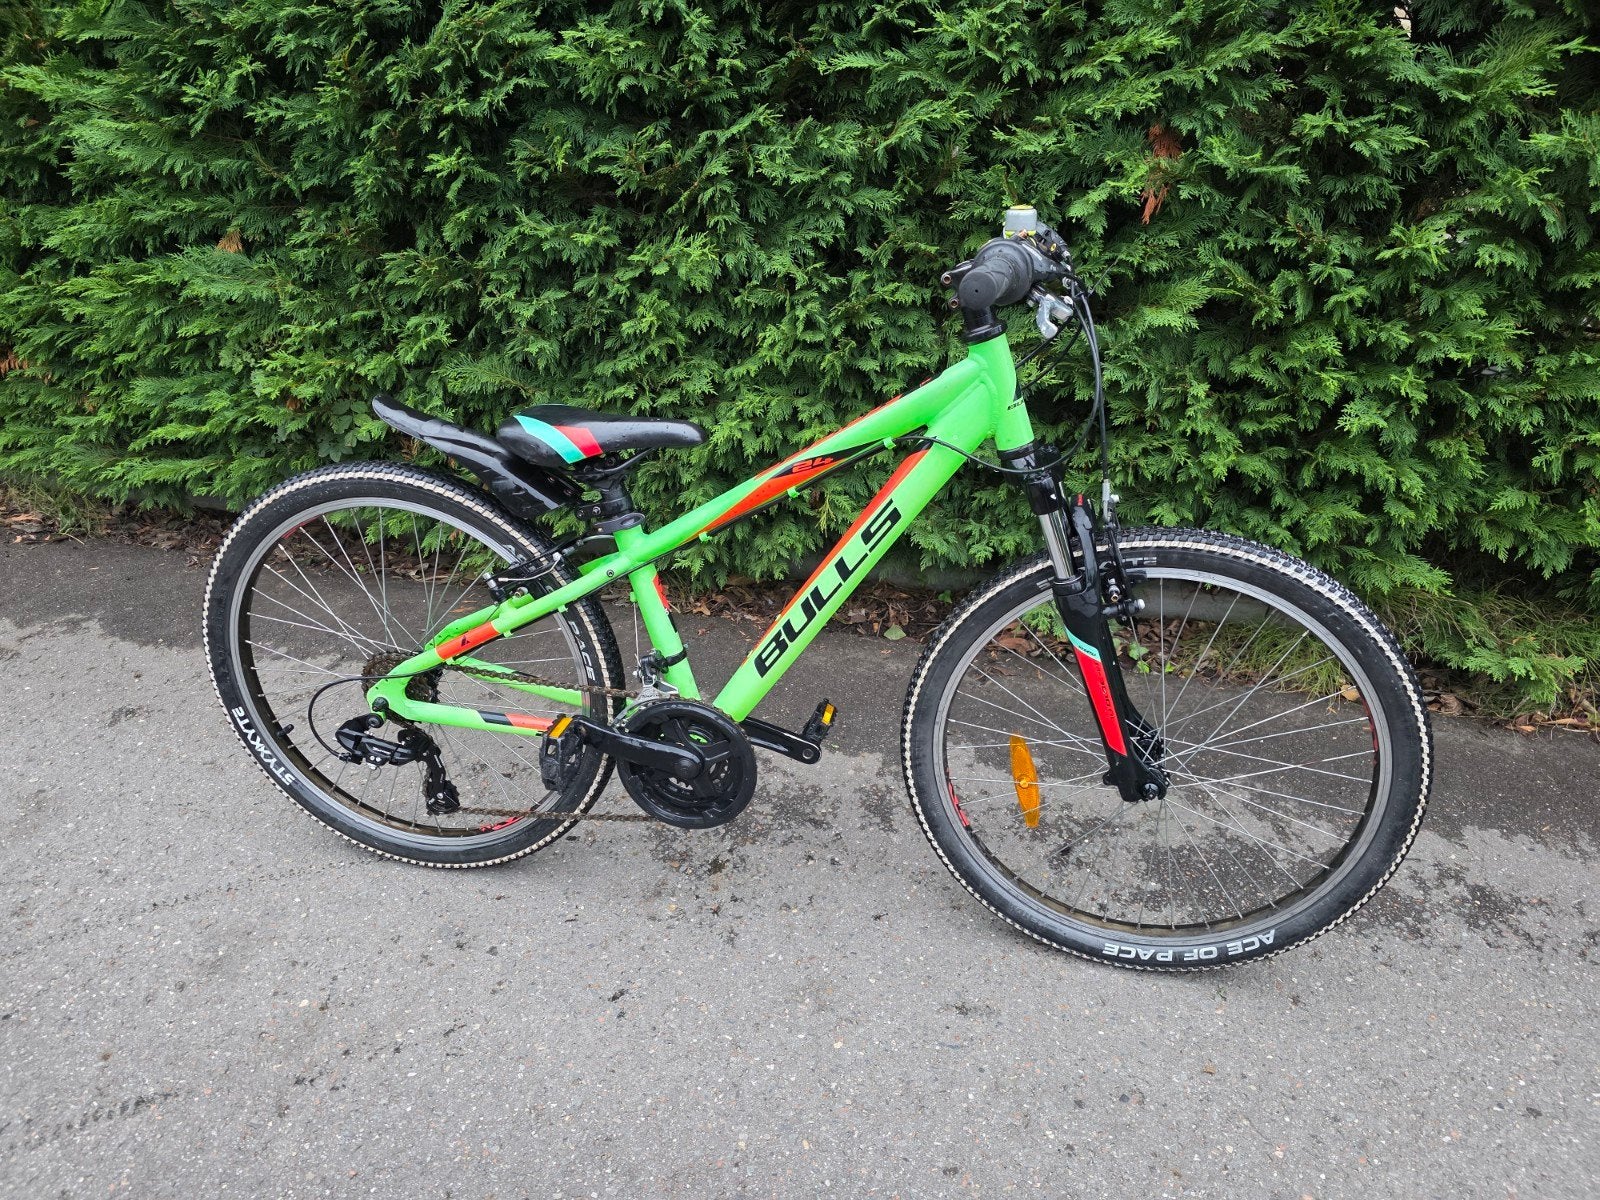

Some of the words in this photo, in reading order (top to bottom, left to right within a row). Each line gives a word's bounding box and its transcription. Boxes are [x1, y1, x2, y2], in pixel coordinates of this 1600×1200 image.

[791, 456, 834, 474] 24
[753, 497, 902, 679] BULLS
[1102, 942, 1173, 962] PACE
[1226, 929, 1276, 956] ACE
[1183, 946, 1218, 961] OF
